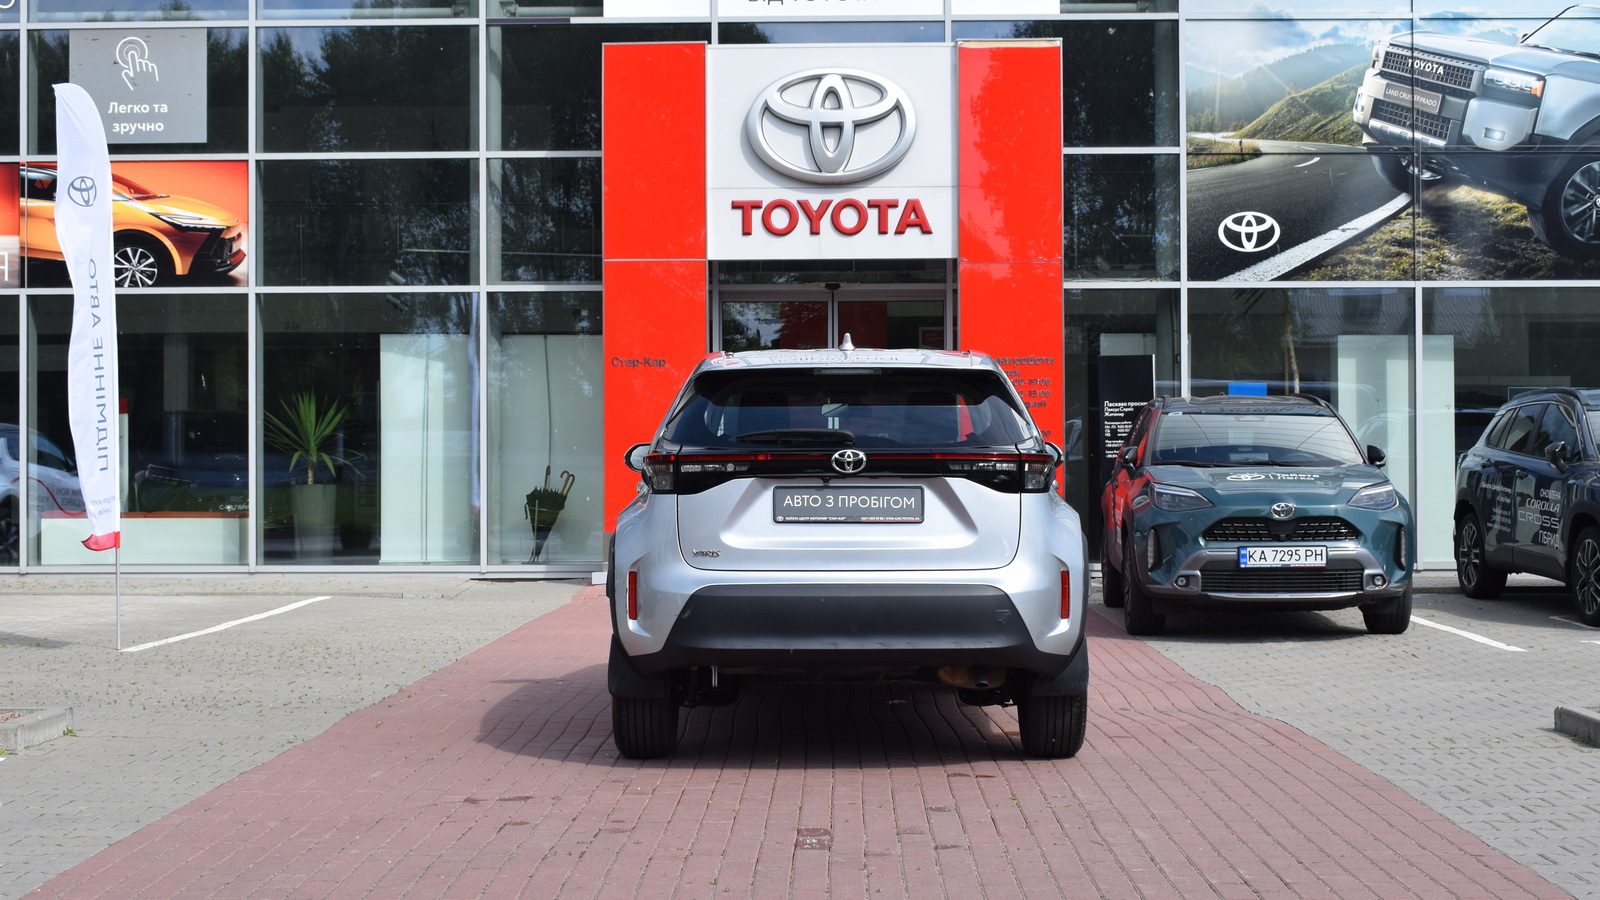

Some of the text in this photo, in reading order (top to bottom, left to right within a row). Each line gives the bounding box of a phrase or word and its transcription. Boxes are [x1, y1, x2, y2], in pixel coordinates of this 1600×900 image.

[1408, 59, 1444, 75] TOYOTA
[1385, 88, 1399, 97] LAND
[1419, 97, 1437, 107] PRADO
[108, 102, 168, 113] Легко та
[112, 122, 164, 135] зручно
[731, 198, 933, 236] TOYOTA
[611, 356, 667, 369] Стар-Кар
[1014, 355, 1054, 366] роботи
[783, 495, 915, 509] АВТО З ПРОБІГОМ
[1526, 498, 1560, 512] COROLLA
[1518, 510, 1560, 529] CROSS
[1248, 549, 1323, 562] KA 7295 PH
